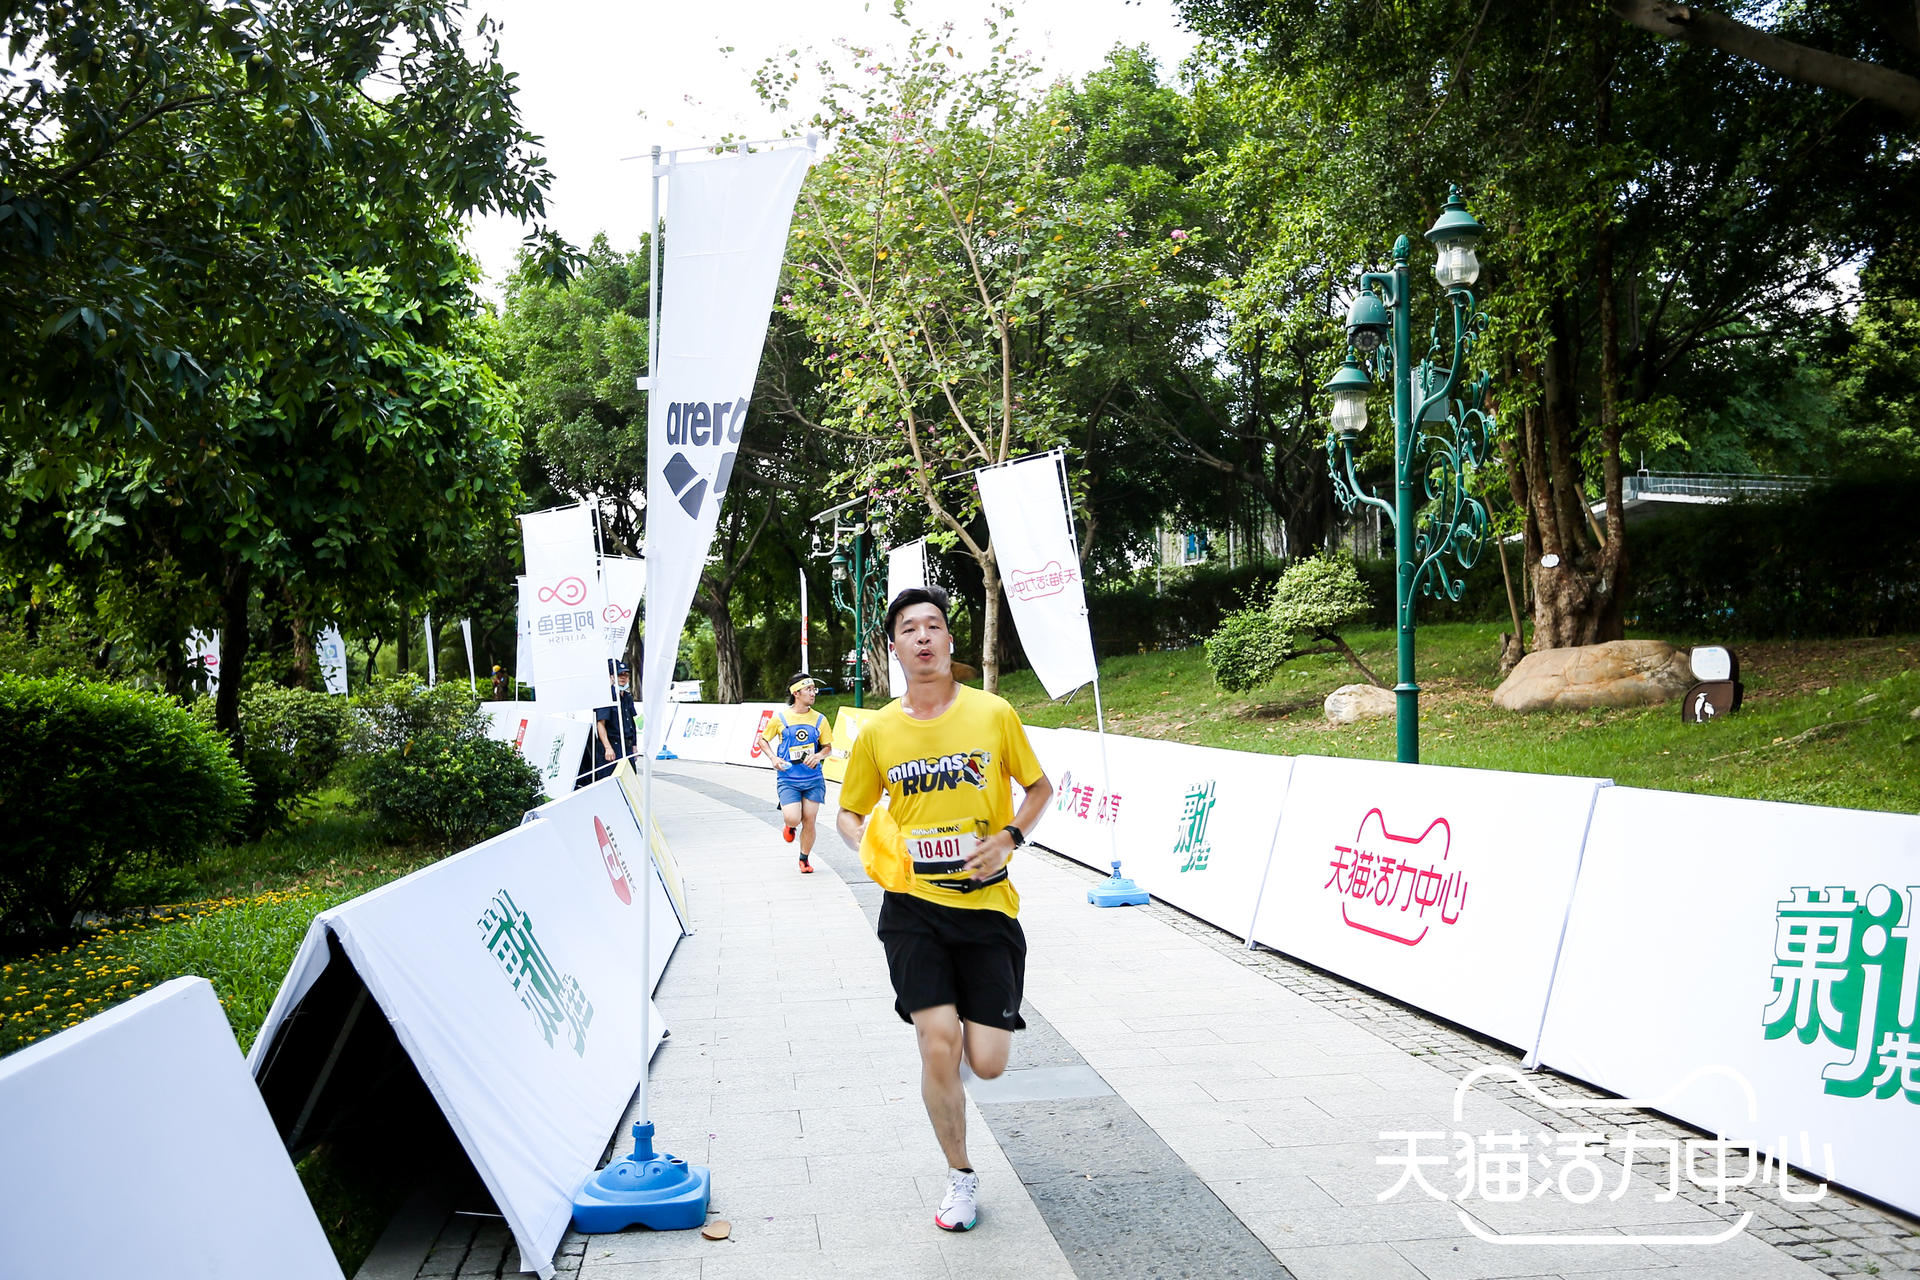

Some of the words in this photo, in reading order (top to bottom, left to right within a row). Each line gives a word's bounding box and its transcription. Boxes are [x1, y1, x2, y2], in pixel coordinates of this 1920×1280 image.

[902, 769, 960, 796] RUN
[917, 838, 961, 859] 10401
[1323, 845, 1468, 925] 天猫活力中心
